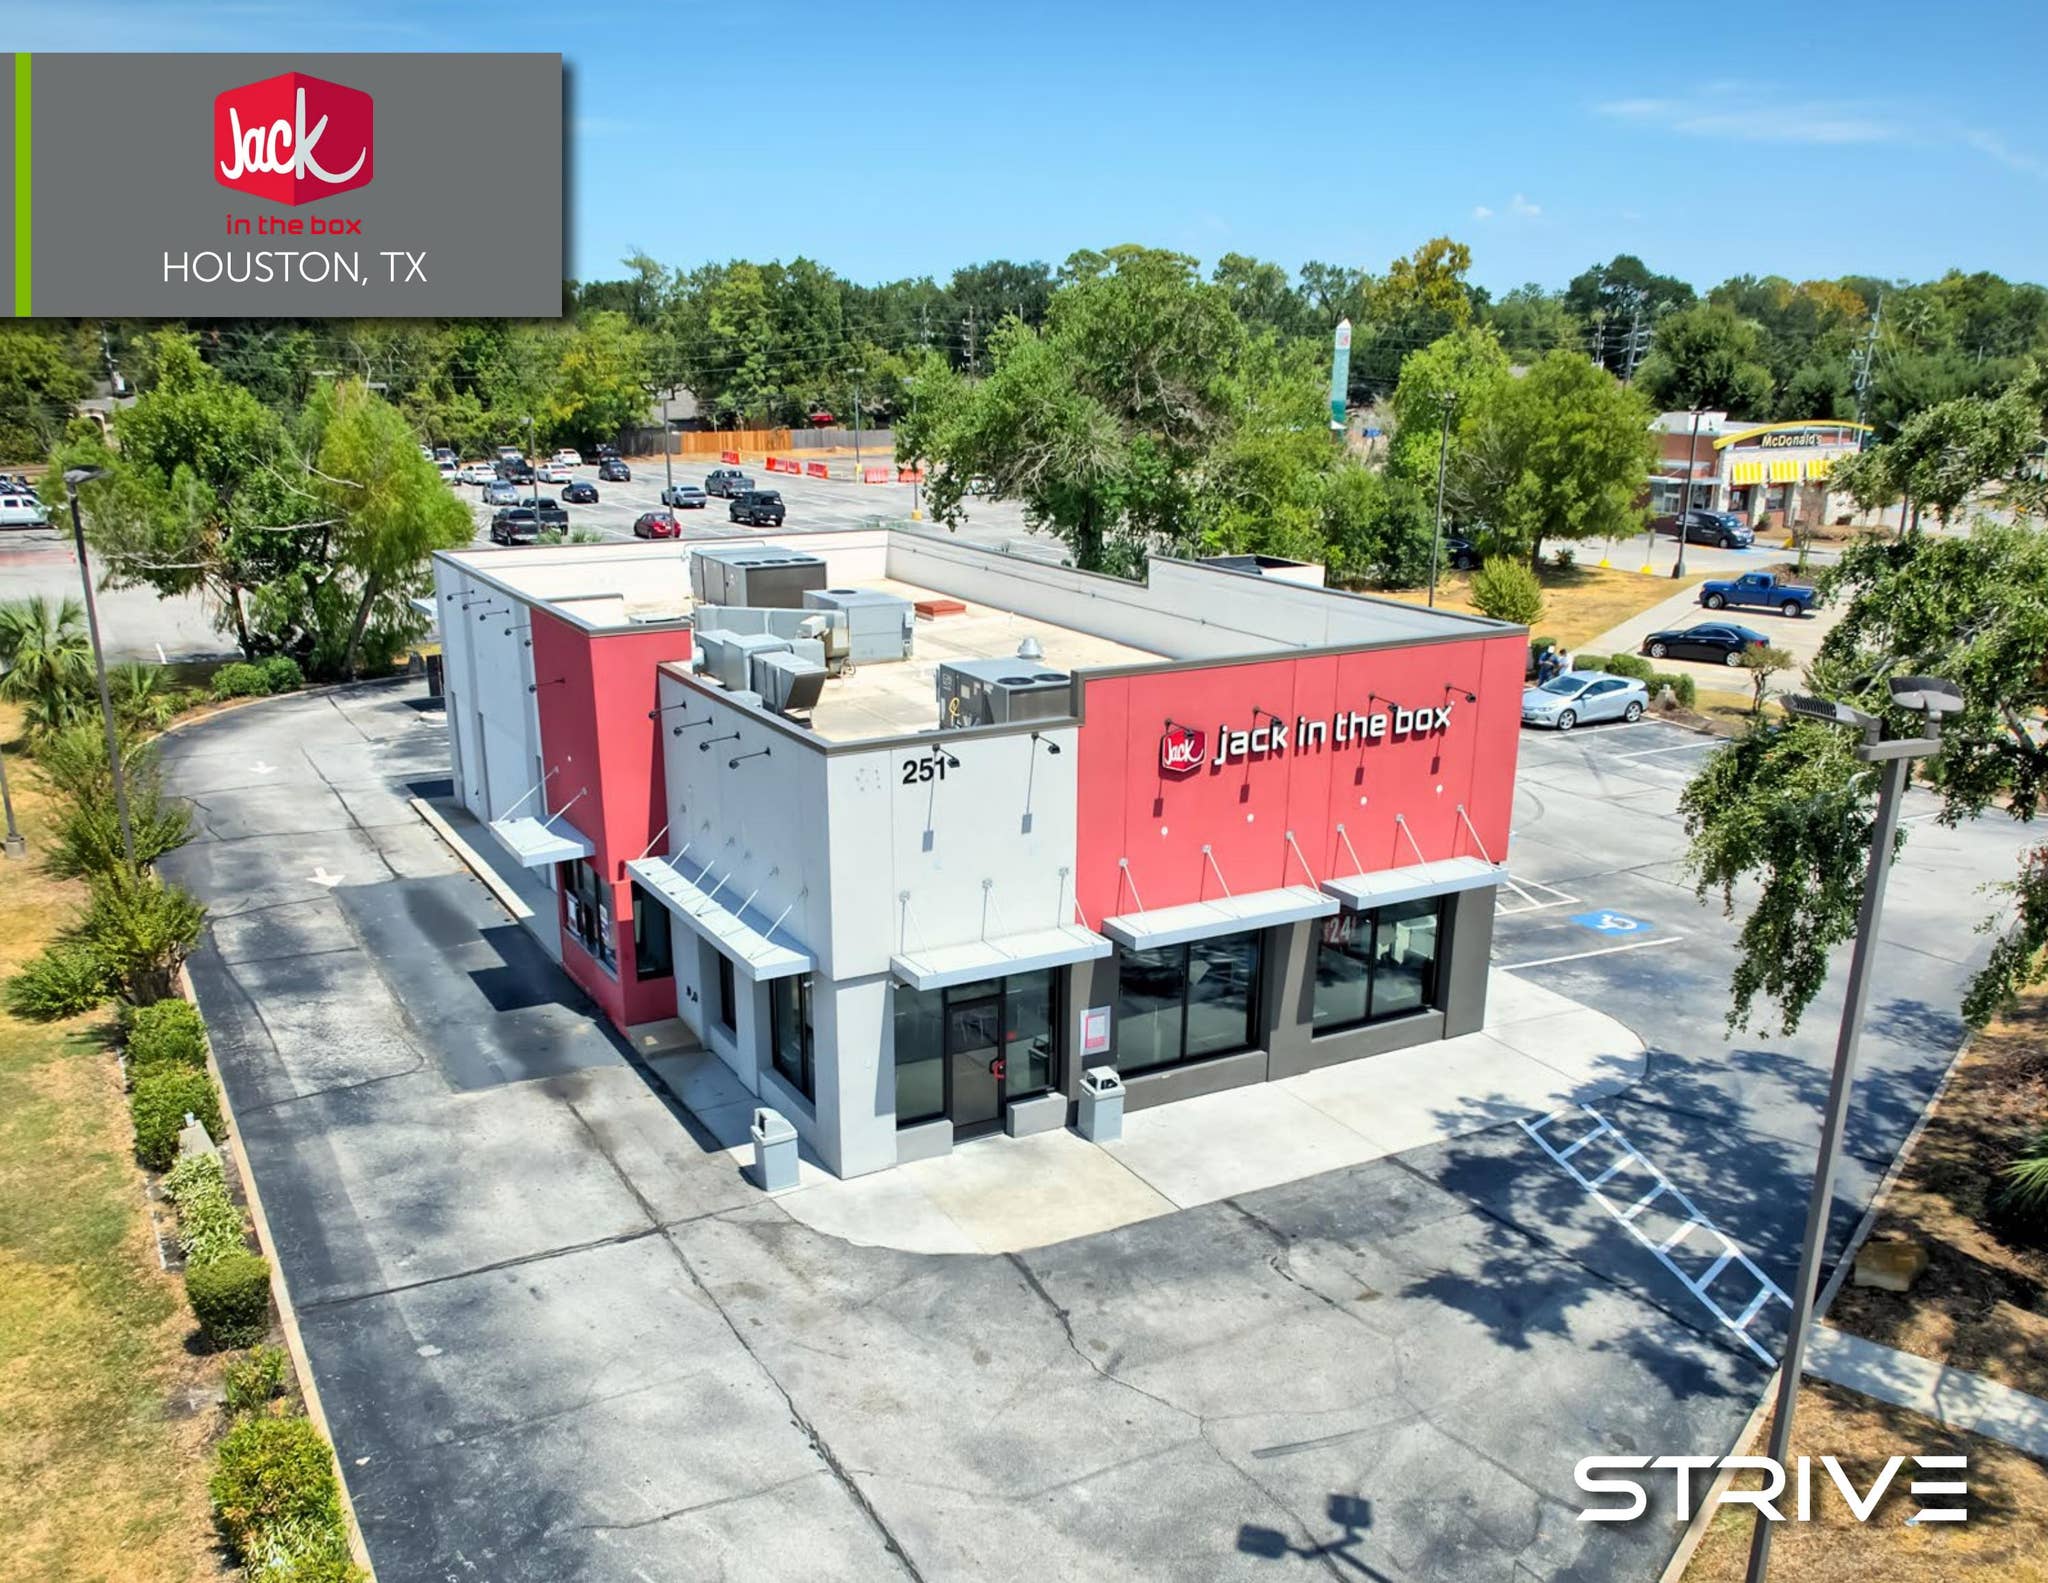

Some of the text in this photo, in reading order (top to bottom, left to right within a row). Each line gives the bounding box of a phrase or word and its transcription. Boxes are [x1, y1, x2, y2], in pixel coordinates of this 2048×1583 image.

[1213, 704, 1452, 766] jack in the box
[902, 756, 945, 785] 251
